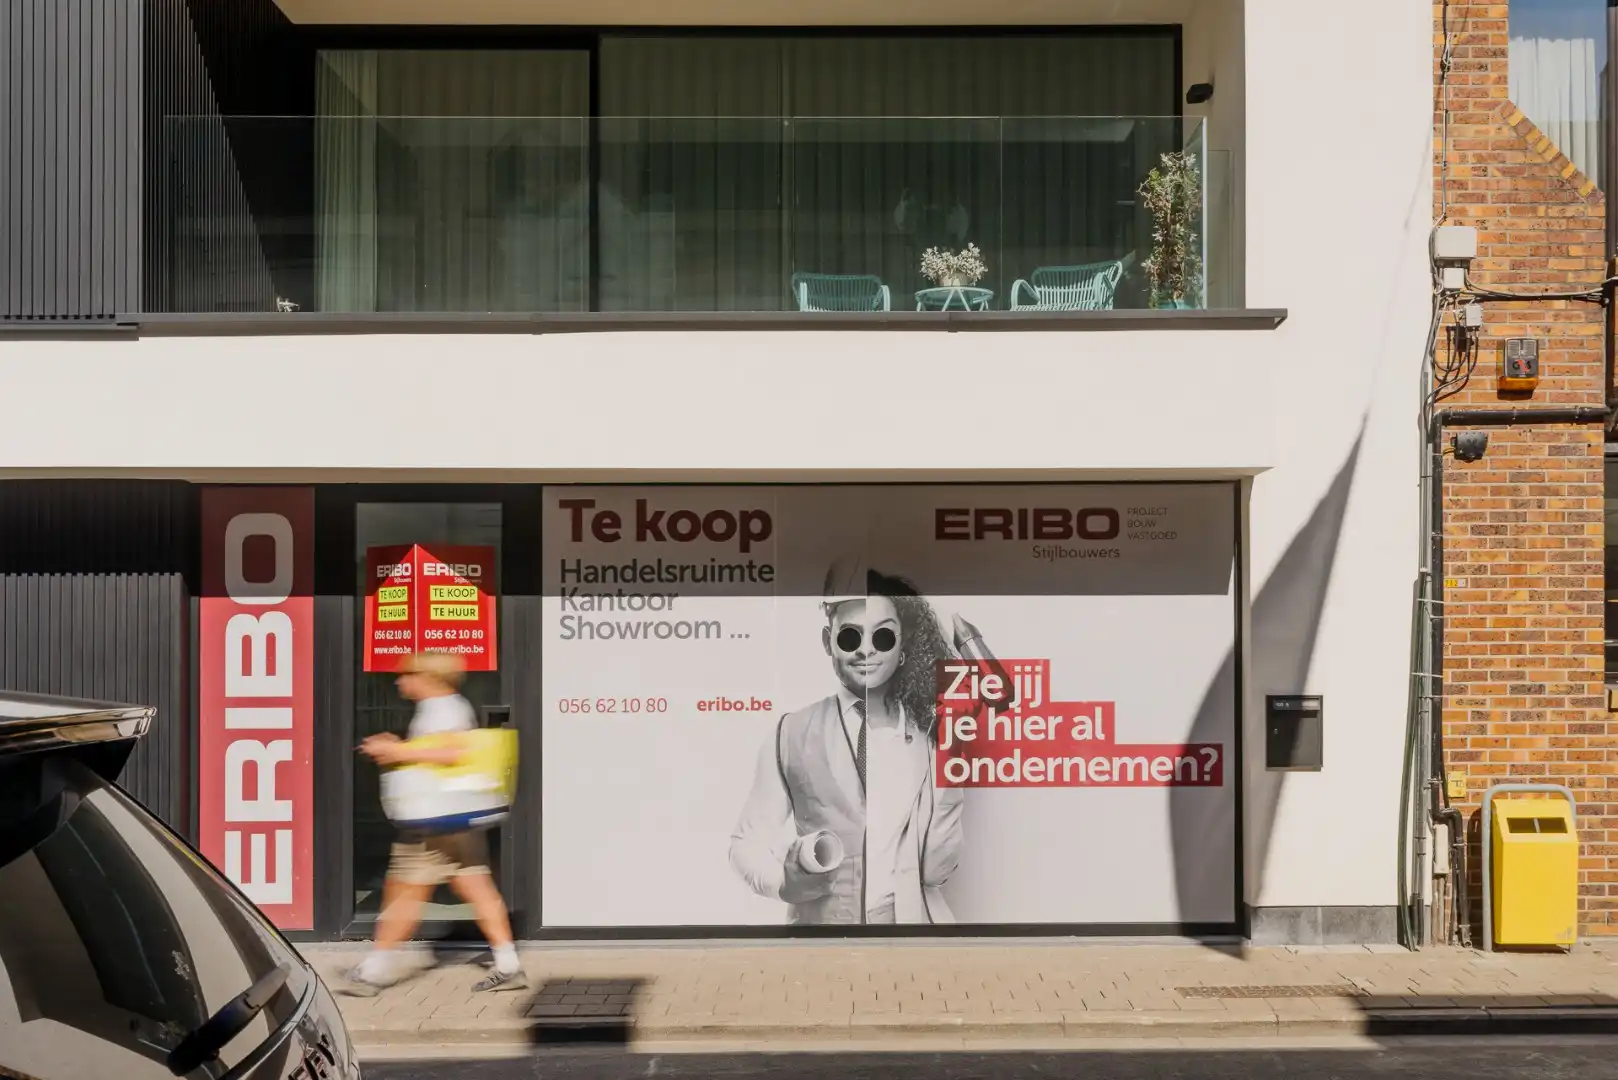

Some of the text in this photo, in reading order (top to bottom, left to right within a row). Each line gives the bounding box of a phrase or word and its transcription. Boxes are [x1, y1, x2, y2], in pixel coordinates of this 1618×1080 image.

[1127, 507, 1168, 516] PROJECT
[559, 499, 772, 553] Te koop
[935, 508, 1120, 540] ERIBO
[1127, 519, 1157, 528] BOUW
[1127, 531, 1178, 540] VASTGOED
[1032, 546, 1120, 561] Stijlbouwers
[376, 563, 412, 577] ERIBO
[423, 562, 481, 577] ERIBO
[560, 558, 775, 583] Handelsruimte
[433, 588, 476, 598] TE KOOP
[560, 587, 679, 611] Kantoor
[380, 608, 407, 618] TE HUUR
[433, 607, 476, 617] TE HUUR
[374, 630, 385, 640] 056
[424, 629, 484, 639] 056 62 10 80
[559, 615, 722, 640] Showroom
[374, 645, 412, 655] www.eribo.be
[943, 665, 1043, 708] Zie jij
[225, 513, 293, 904] ERIBO
[558, 698, 668, 713] 056 62 10 80
[696, 696, 773, 712] eribo.be
[939, 706, 1105, 751] je hier al
[943, 747, 1218, 784] ondernemen?
